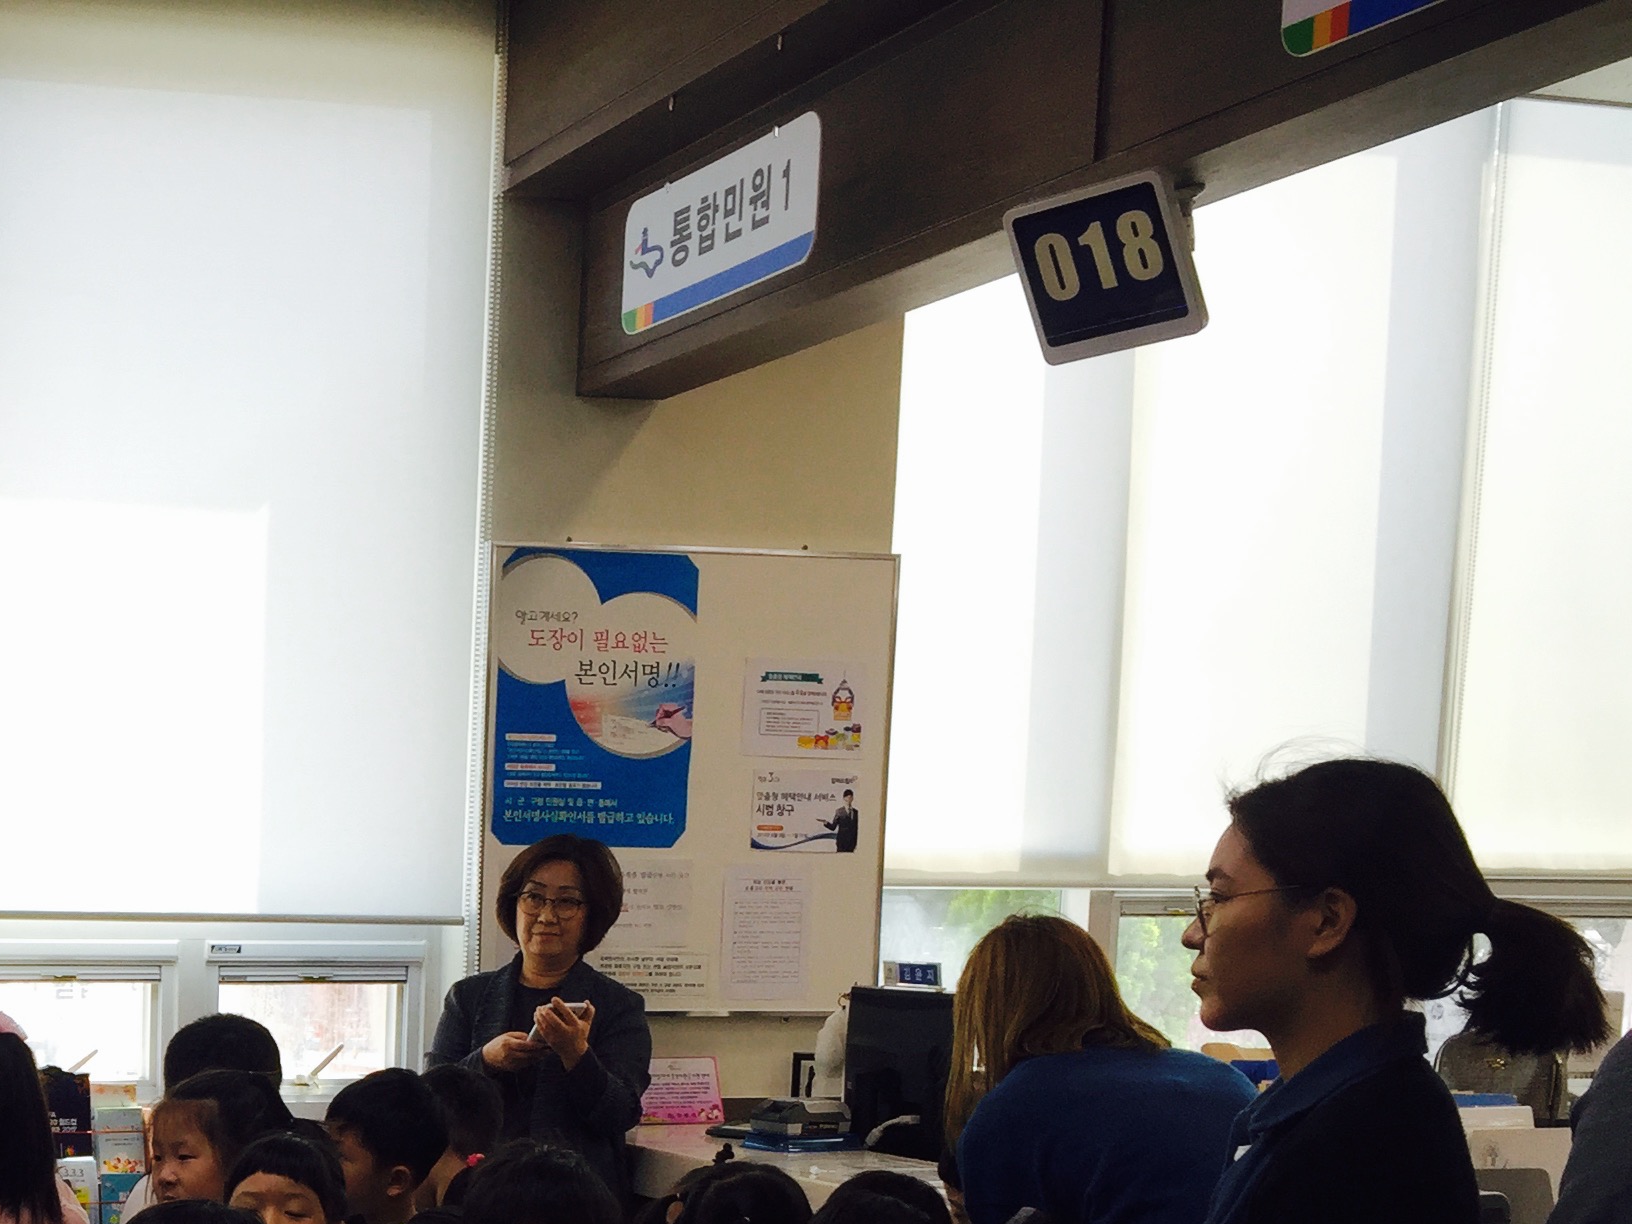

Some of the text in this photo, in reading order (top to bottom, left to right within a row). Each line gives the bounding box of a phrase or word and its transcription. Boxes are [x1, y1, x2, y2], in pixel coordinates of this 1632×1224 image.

[670, 163, 772, 268] 통합민원
[1034, 209, 1164, 301] 018
[528, 627, 669, 654] 도장이 필요없는
[574, 659, 680, 688] 본인서명!!
